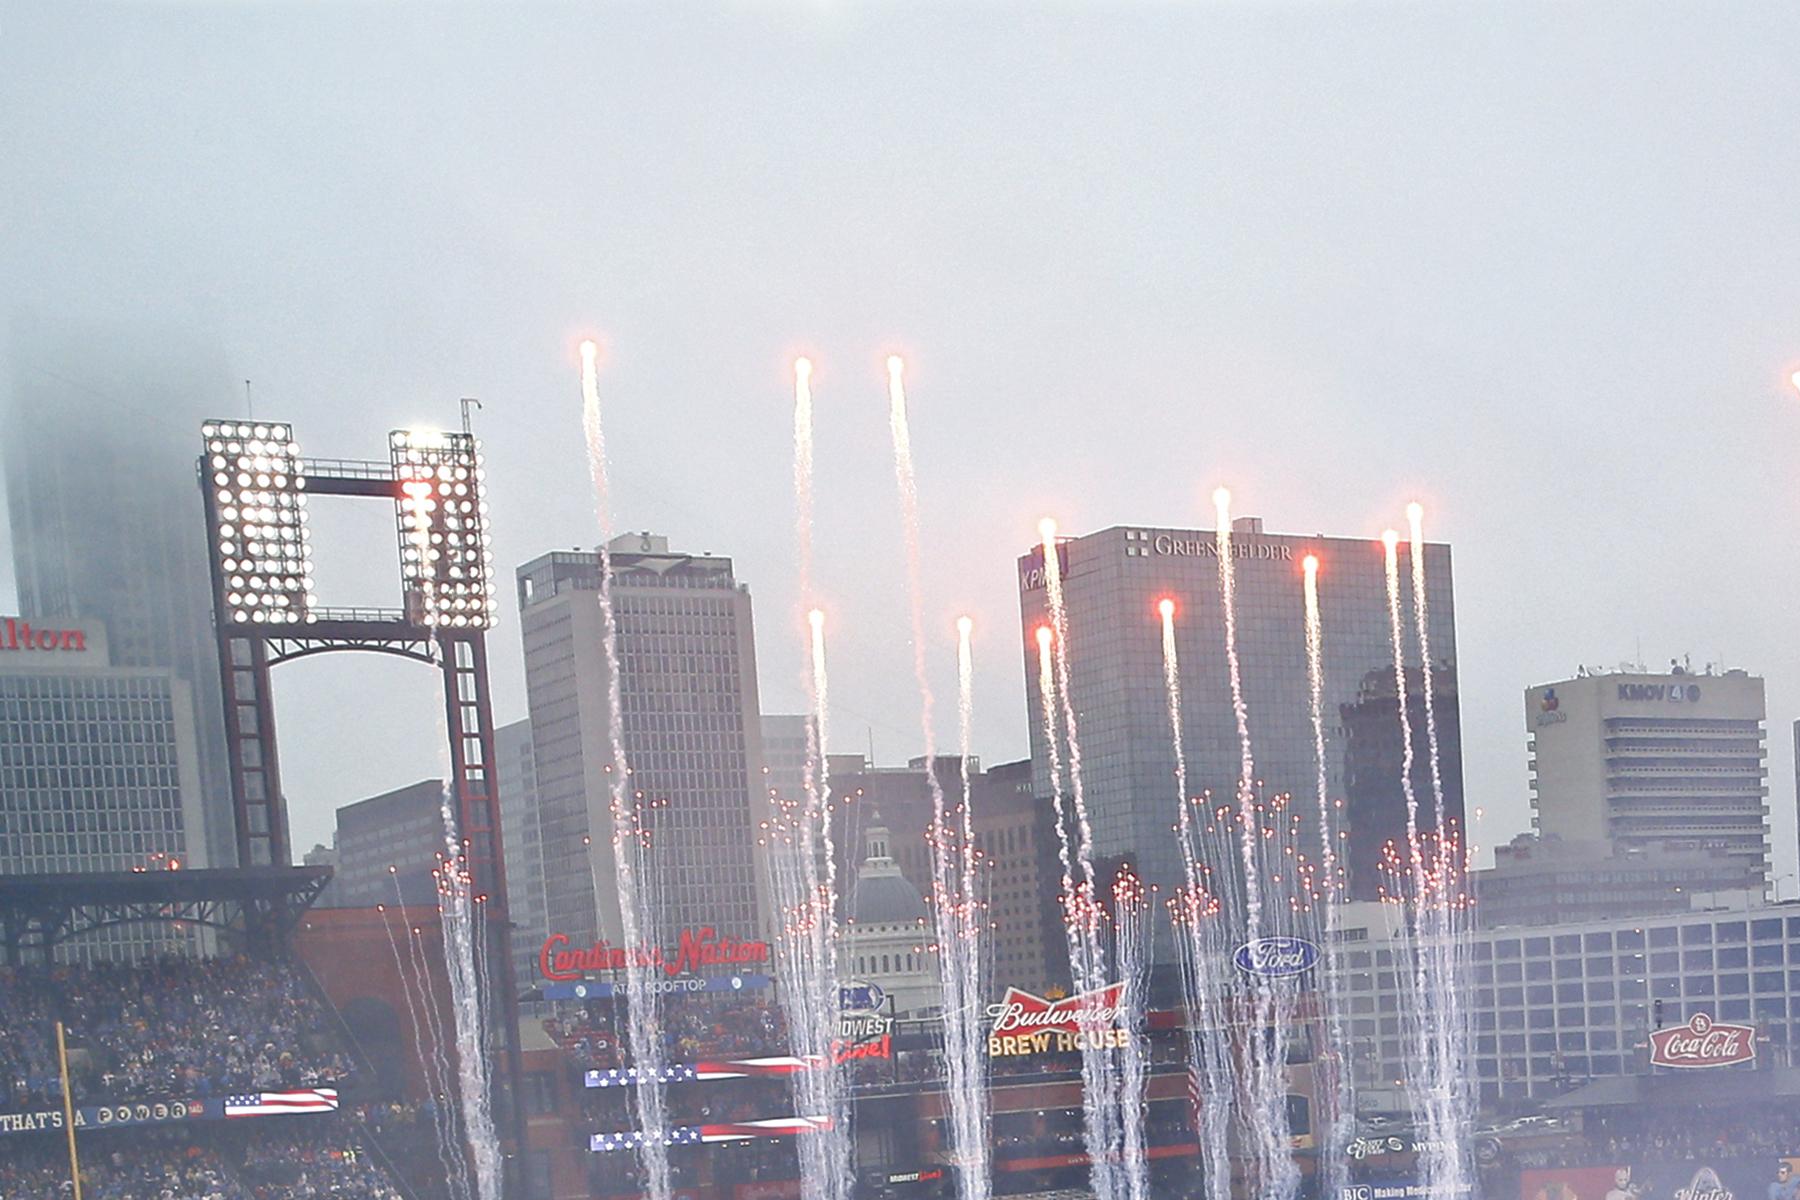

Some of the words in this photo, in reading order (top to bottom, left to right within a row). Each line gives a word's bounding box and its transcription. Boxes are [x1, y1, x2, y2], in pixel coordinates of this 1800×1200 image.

[1154, 535, 1292, 561] GREENFELDER
[0, 617, 86, 651] lton
[1617, 683, 1664, 700] KMOV
[540, 933, 664, 981] Cardinls
[664, 926, 768, 977] Nation
[1255, 942, 1304, 969] Ford
[987, 1000, 1128, 1032] Budweiser
[989, 1032, 1050, 1057] BREW
[1057, 1027, 1131, 1051] HOUSE
[0, 1111, 62, 1131] THAT'S
[74, 1110, 86, 1126] A
